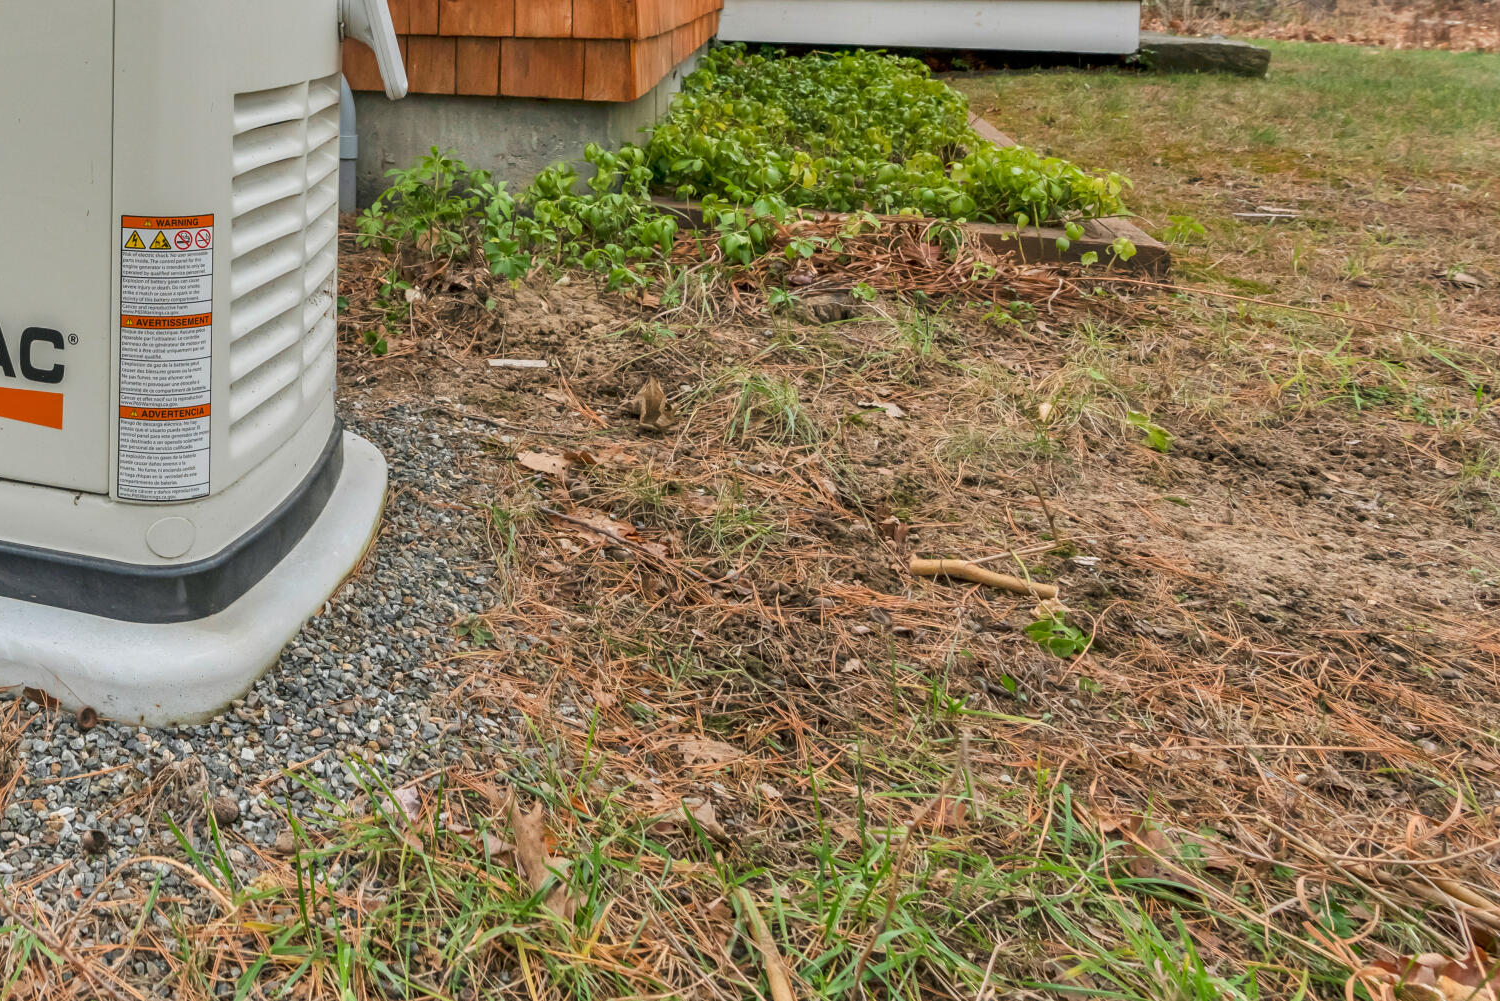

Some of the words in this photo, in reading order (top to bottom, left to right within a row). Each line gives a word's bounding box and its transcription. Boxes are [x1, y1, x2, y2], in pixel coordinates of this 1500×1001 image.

[156, 218, 199, 227] WARNING
[136, 316, 209, 327] AVERTISSEMENT
[141, 407, 204, 418] ADVERTENCIA
